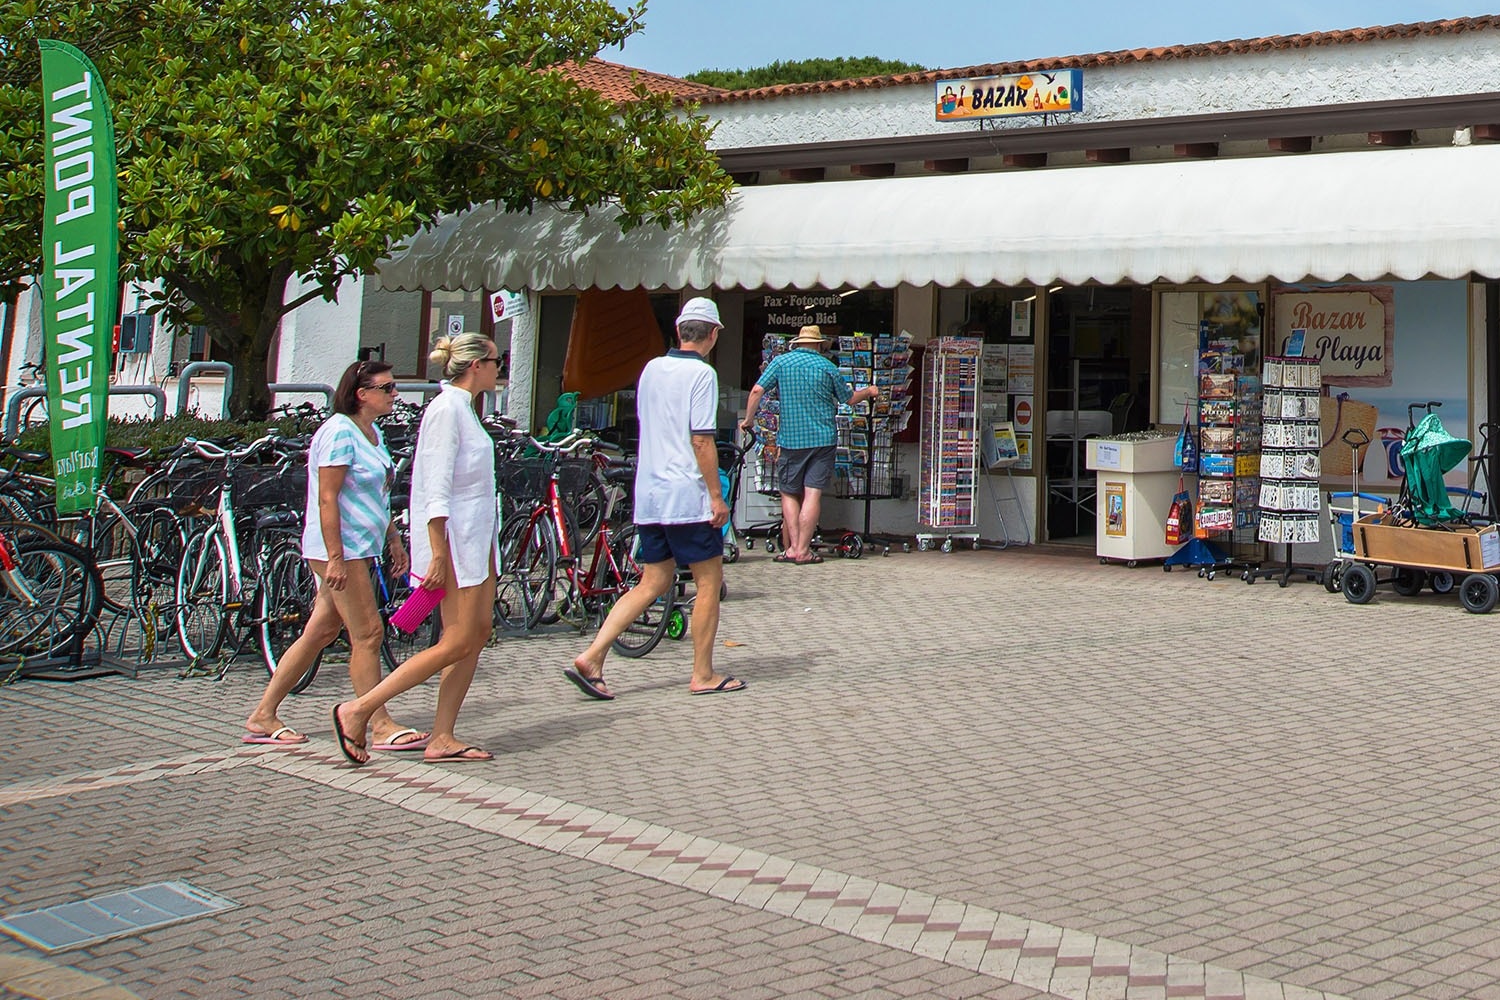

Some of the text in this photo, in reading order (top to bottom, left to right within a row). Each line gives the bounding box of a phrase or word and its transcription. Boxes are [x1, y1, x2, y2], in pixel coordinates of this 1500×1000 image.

[971, 85, 1029, 110] BAZAR
[763, 295, 782, 307] Fax
[789, 294, 842, 308] Fotocopie
[768, 312, 837, 327] Noleggio Bici
[1291, 301, 1367, 330] Bazar
[1316, 335, 1383, 370] Playa
